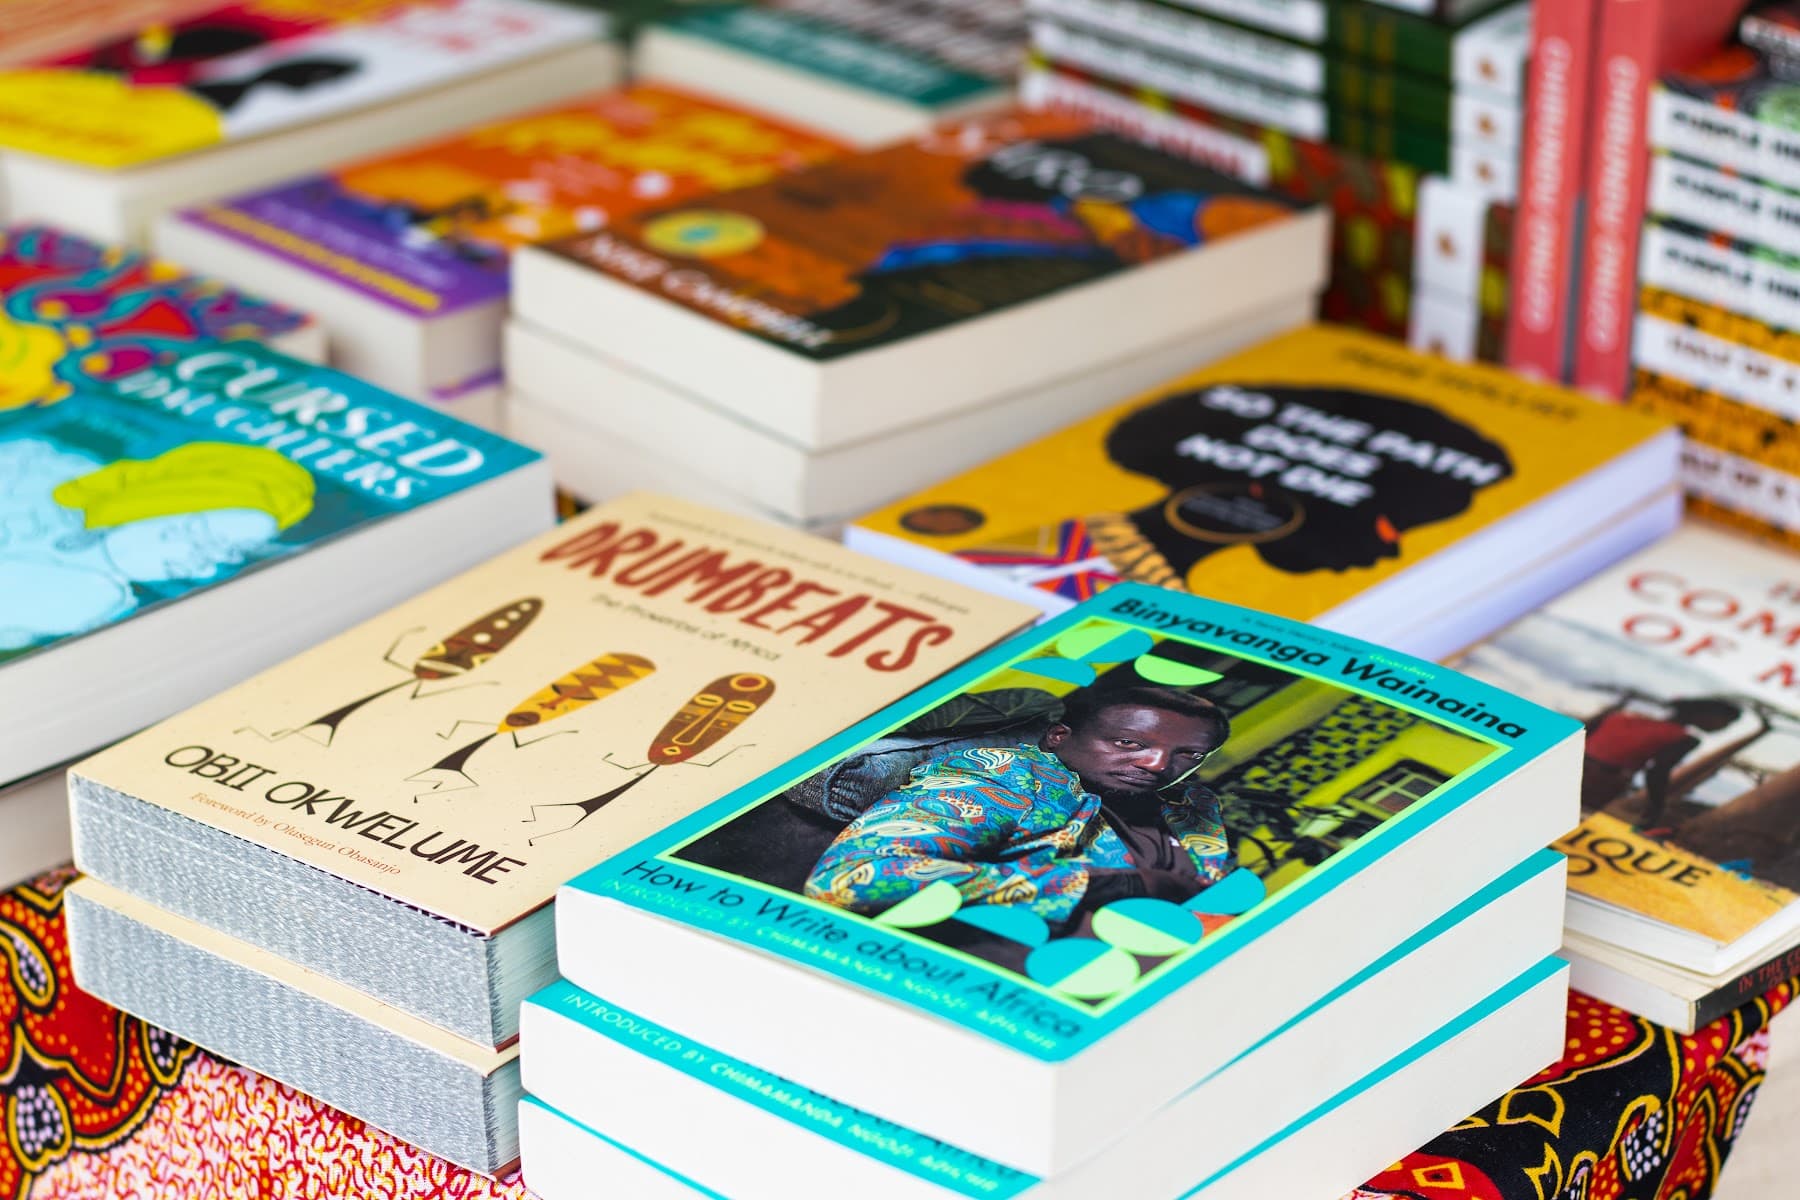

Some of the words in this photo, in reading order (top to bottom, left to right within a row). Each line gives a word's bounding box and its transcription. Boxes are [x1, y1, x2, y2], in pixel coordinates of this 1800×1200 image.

[176, 351, 485, 476] CURSED
[1203, 384, 1276, 419] SO
[1276, 401, 1374, 446] THE
[1366, 429, 1504, 488] PATH
[1242, 423, 1381, 478] DOES
[1177, 434, 1290, 478] NOT
[1278, 464, 1374, 508] DIE
[538, 520, 955, 673] DRUMBEATS
[1621, 613, 1738, 658] OF
[1110, 598, 1331, 667] Binyavanga
[1340, 657, 1527, 739] Wainaina
[189, 791, 256, 820] Foreword
[253, 814, 273, 827] by
[272, 822, 336, 852] Olusegun
[337, 846, 402, 876] Obasanjo
[264, 781, 528, 884] OKWELUME
[1563, 829, 1711, 888] IQUE
[602, 878, 724, 921] INTRODUCED
[622, 860, 707, 894] How
[707, 887, 744, 908] to
[755, 898, 850, 944] Write
[855, 941, 966, 985] about
[965, 979, 1081, 1037] Africa
[563, 993, 682, 1051] INTRODUCED
[681, 1049, 708, 1064] BY
[709, 1061, 844, 1129] CHIMAMANDA
